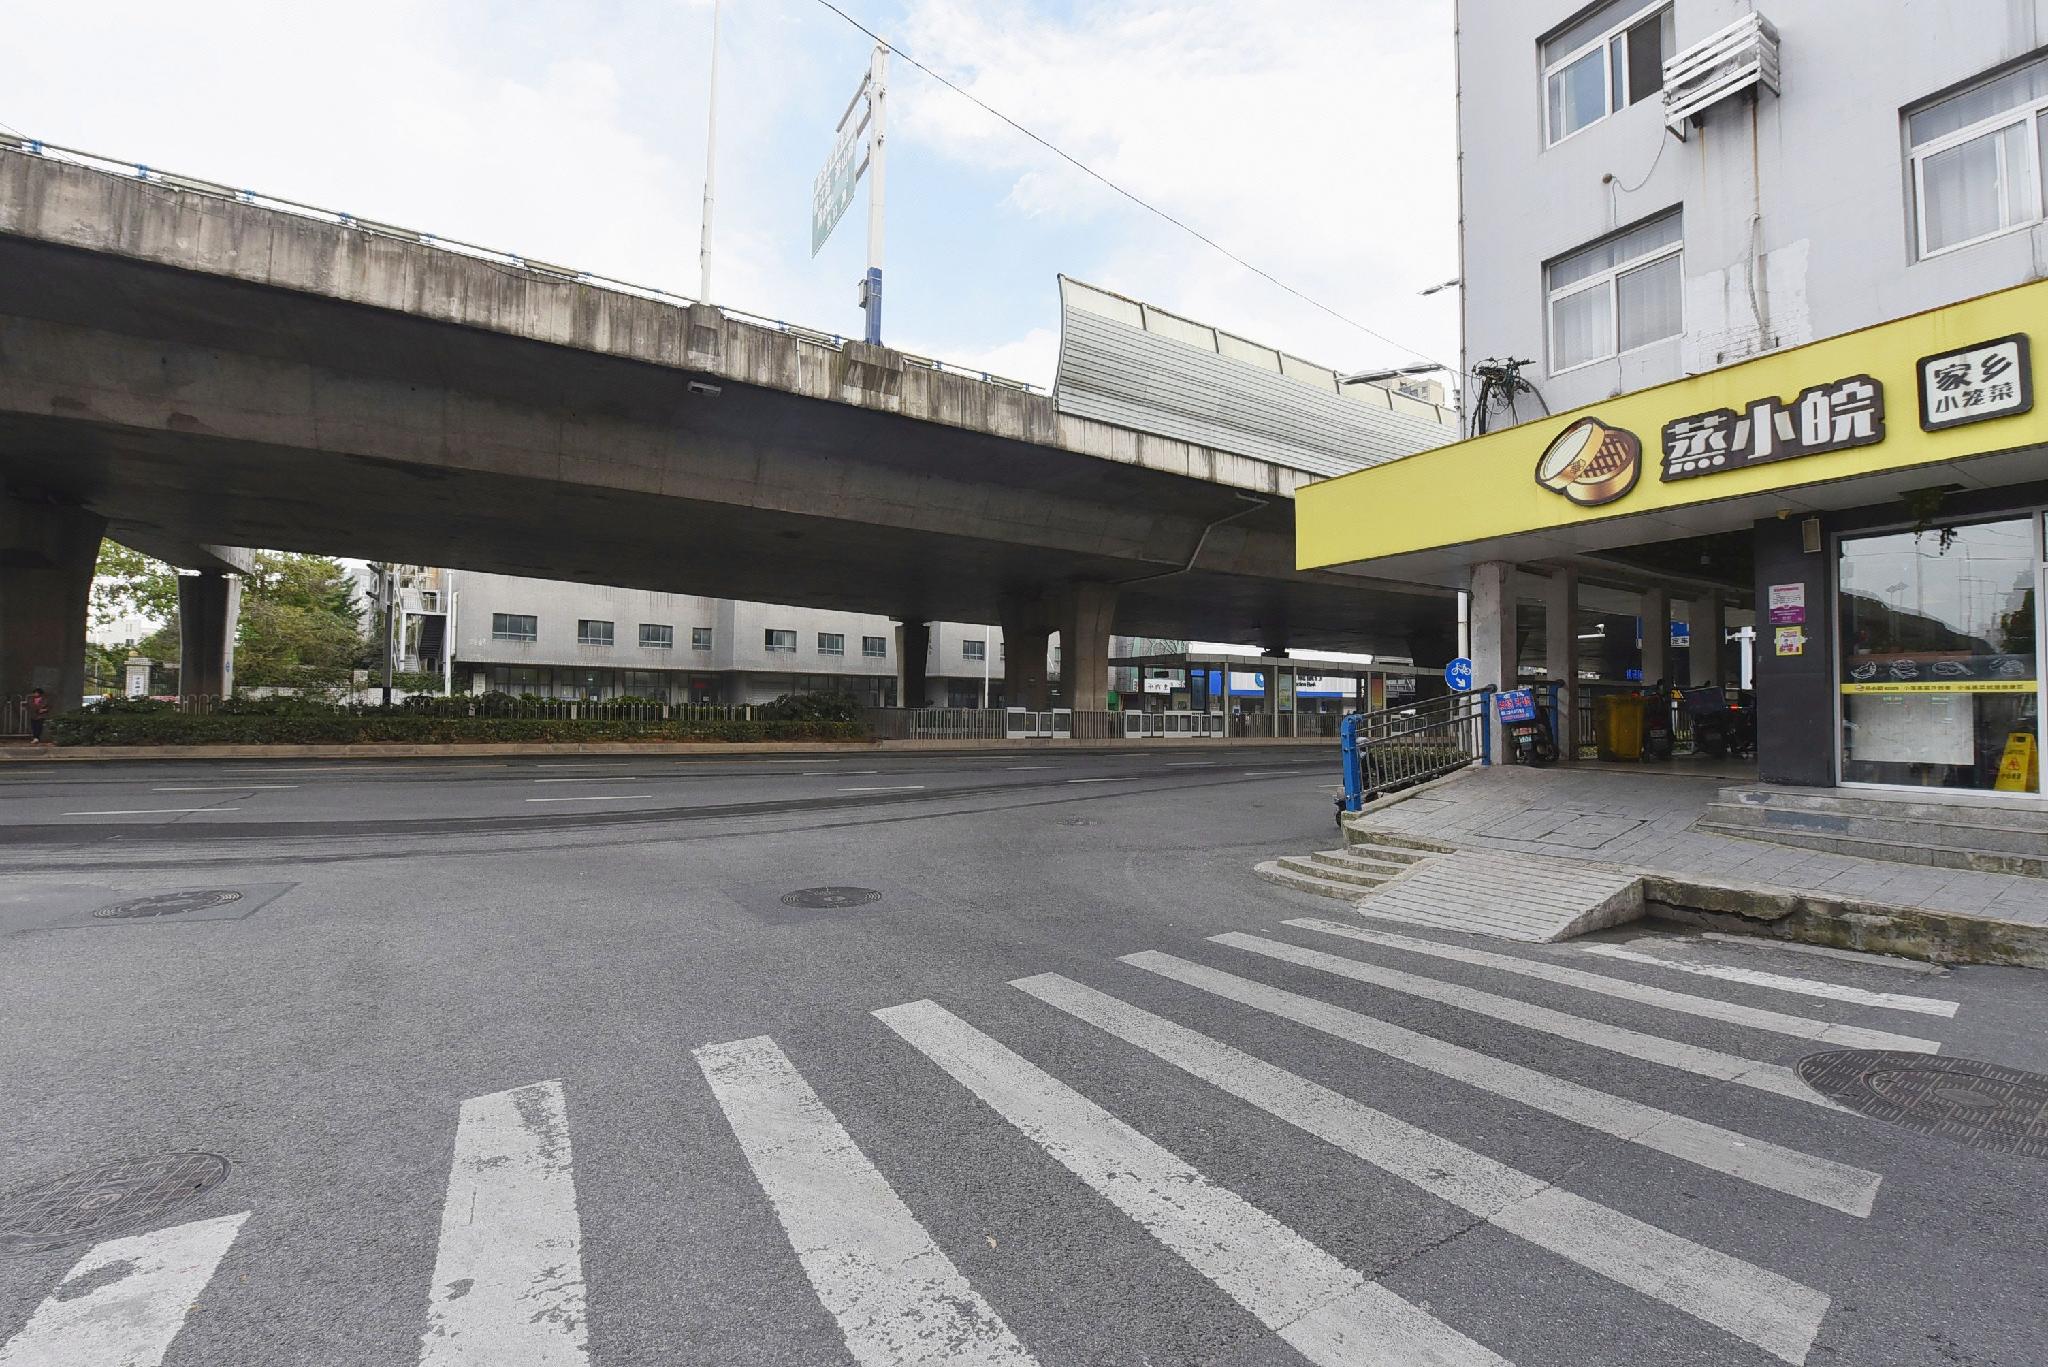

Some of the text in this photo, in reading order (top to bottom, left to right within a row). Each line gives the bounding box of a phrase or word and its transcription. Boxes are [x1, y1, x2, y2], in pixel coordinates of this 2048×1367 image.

[1934, 353, 2013, 391] 家乡
[1935, 382, 2013, 413] 小笼菜
[1667, 381, 1876, 475] 蒸小皖
